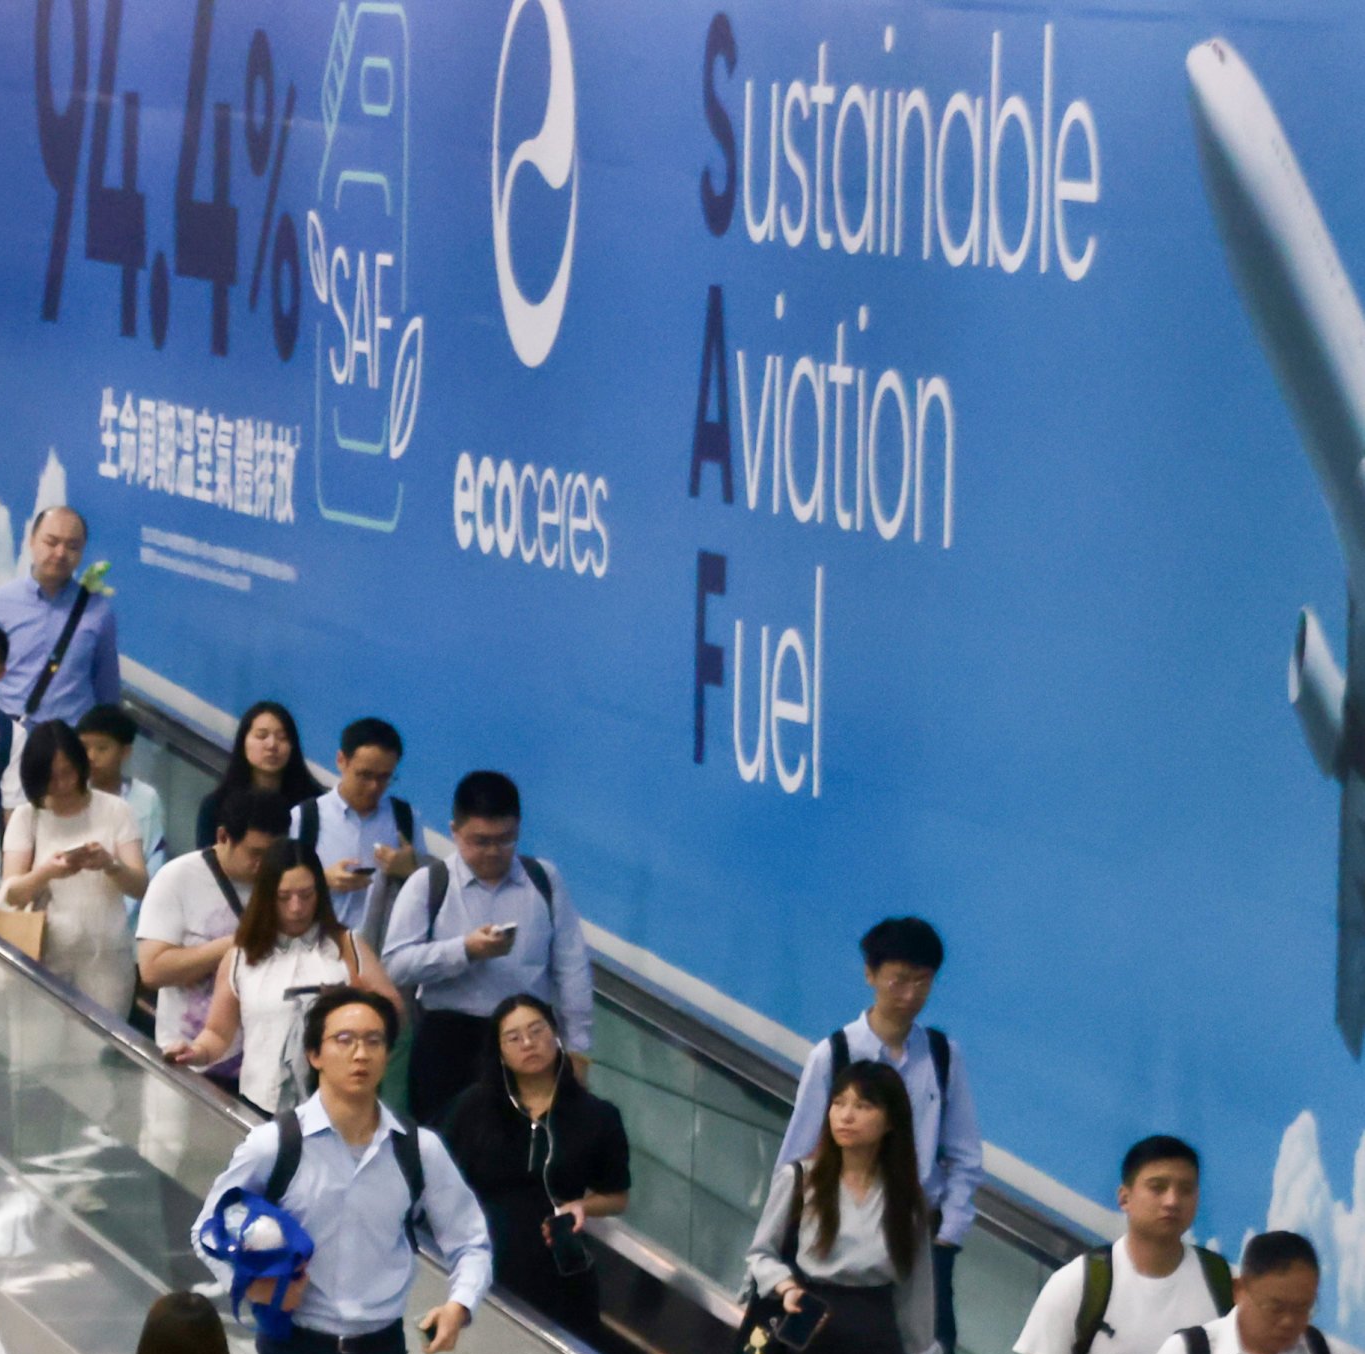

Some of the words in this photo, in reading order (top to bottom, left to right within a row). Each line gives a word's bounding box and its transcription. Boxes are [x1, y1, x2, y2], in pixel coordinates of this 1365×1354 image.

[699, 11, 1101, 281] Sustainable
[330, 246, 394, 389] SAF
[688, 284, 956, 550] Aviation
[453, 452, 610, 579] ecoceres
[693, 549, 825, 798] Fuel
